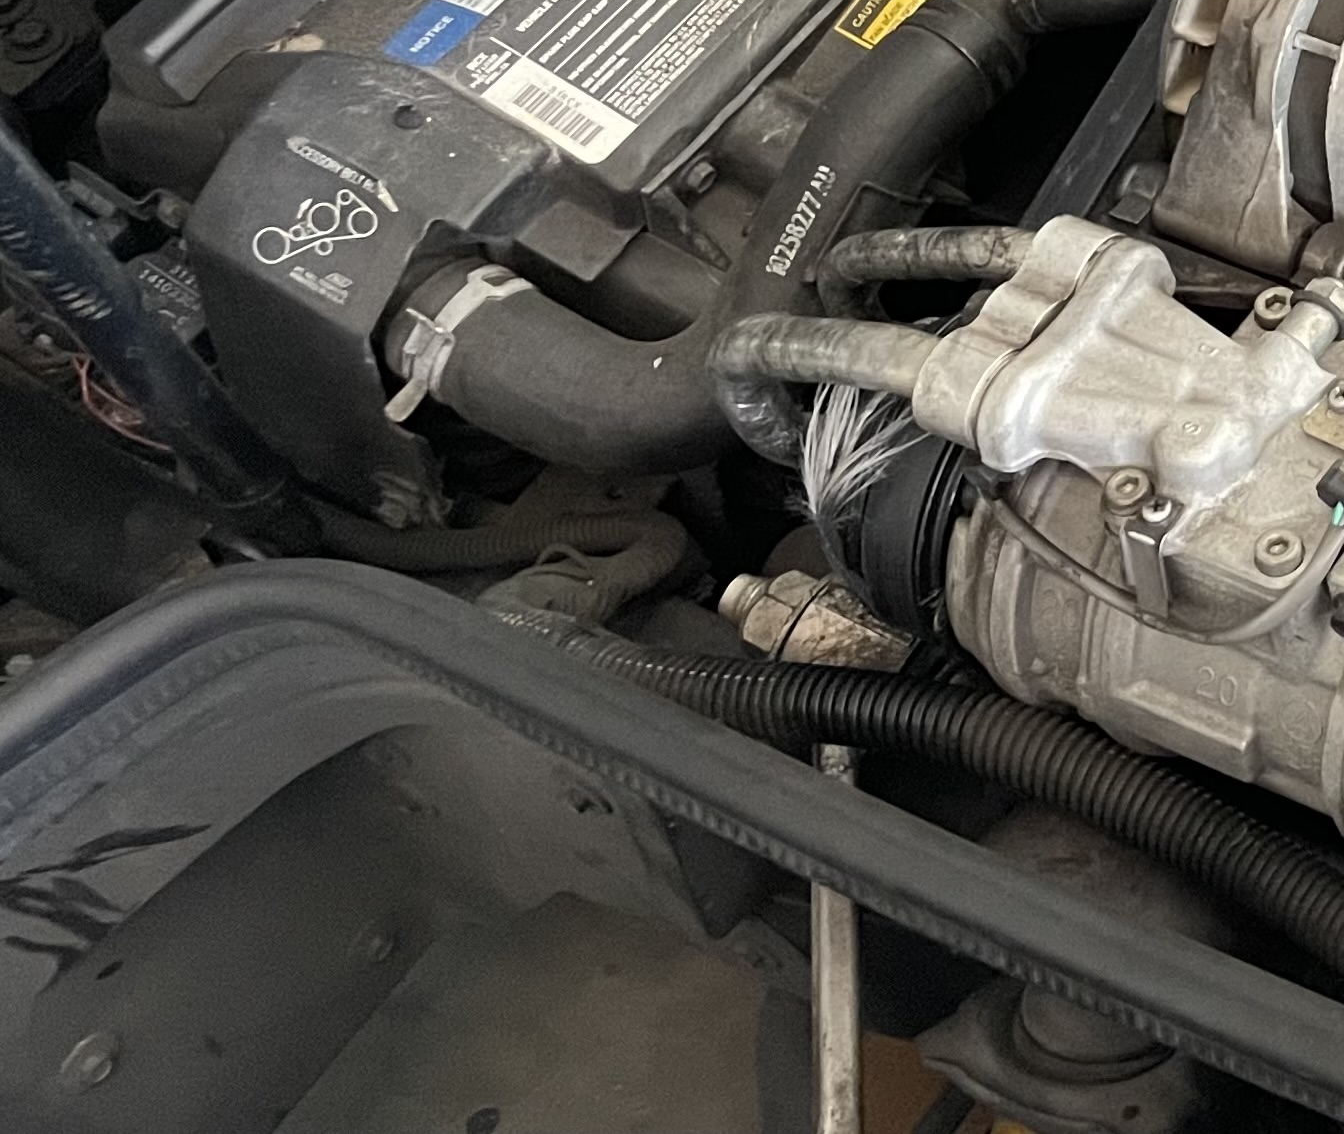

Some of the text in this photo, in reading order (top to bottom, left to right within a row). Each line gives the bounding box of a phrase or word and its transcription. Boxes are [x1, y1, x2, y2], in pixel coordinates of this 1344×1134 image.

[408, 14, 454, 52] NOTICE
[764, 189, 823, 277] 10258277
[1195, 666, 1239, 706] 20
